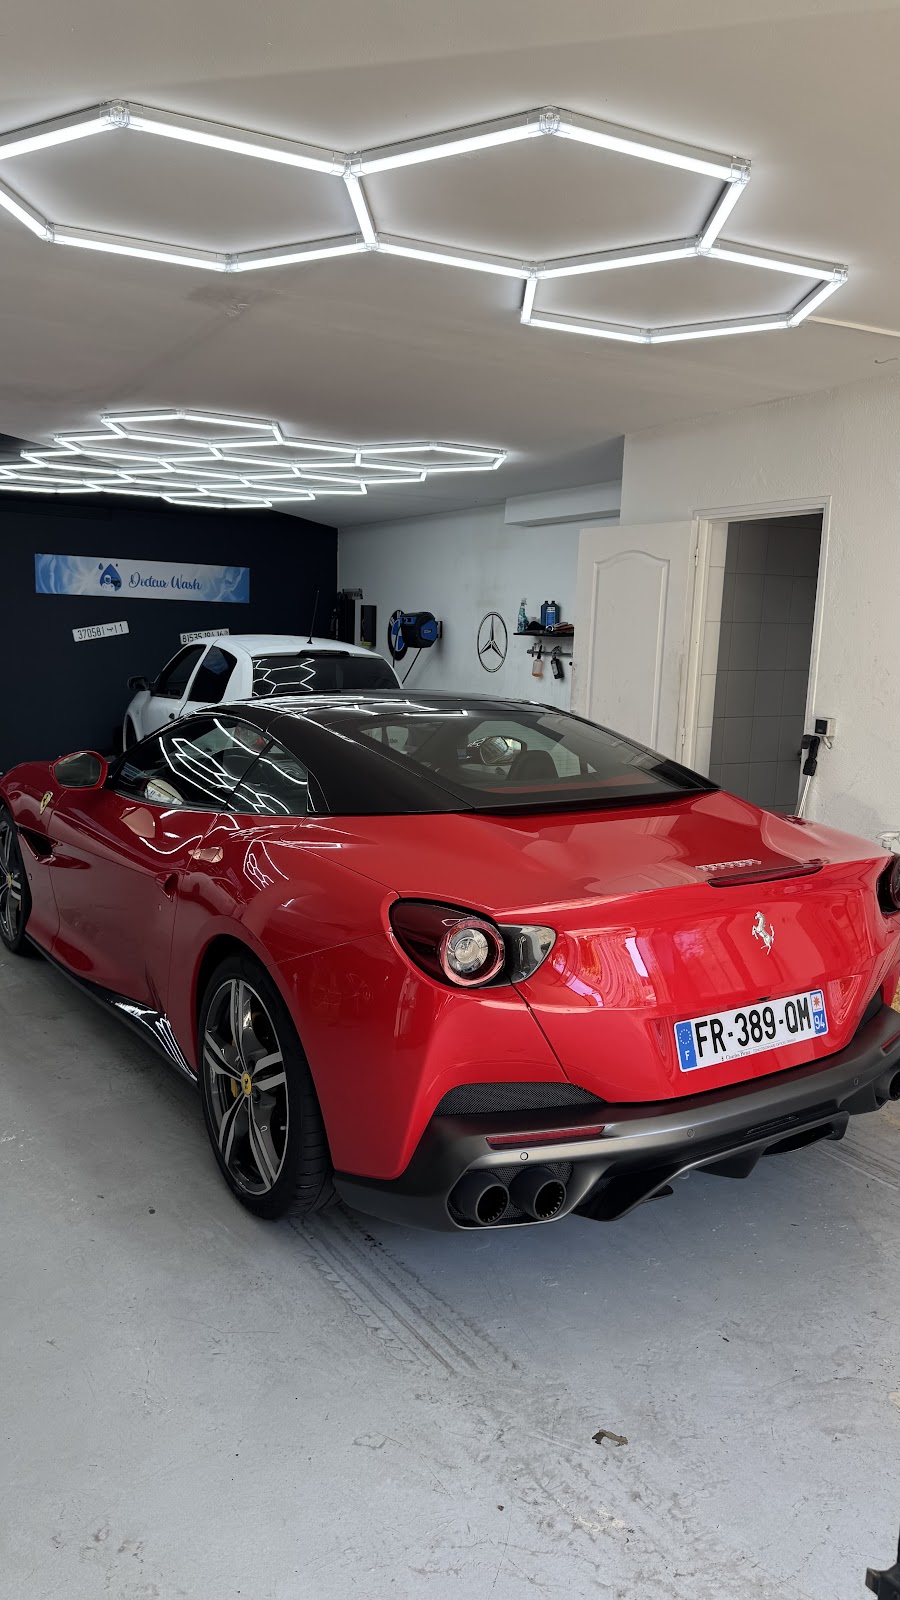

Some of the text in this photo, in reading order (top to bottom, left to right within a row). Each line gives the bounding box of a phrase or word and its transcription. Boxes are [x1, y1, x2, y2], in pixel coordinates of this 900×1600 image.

[128, 571, 203, 590] Docteur Wash
[694, 997, 812, 1058] FR-389-QM
[813, 1013, 826, 1030] 94
[684, 1051, 690, 1061] F
